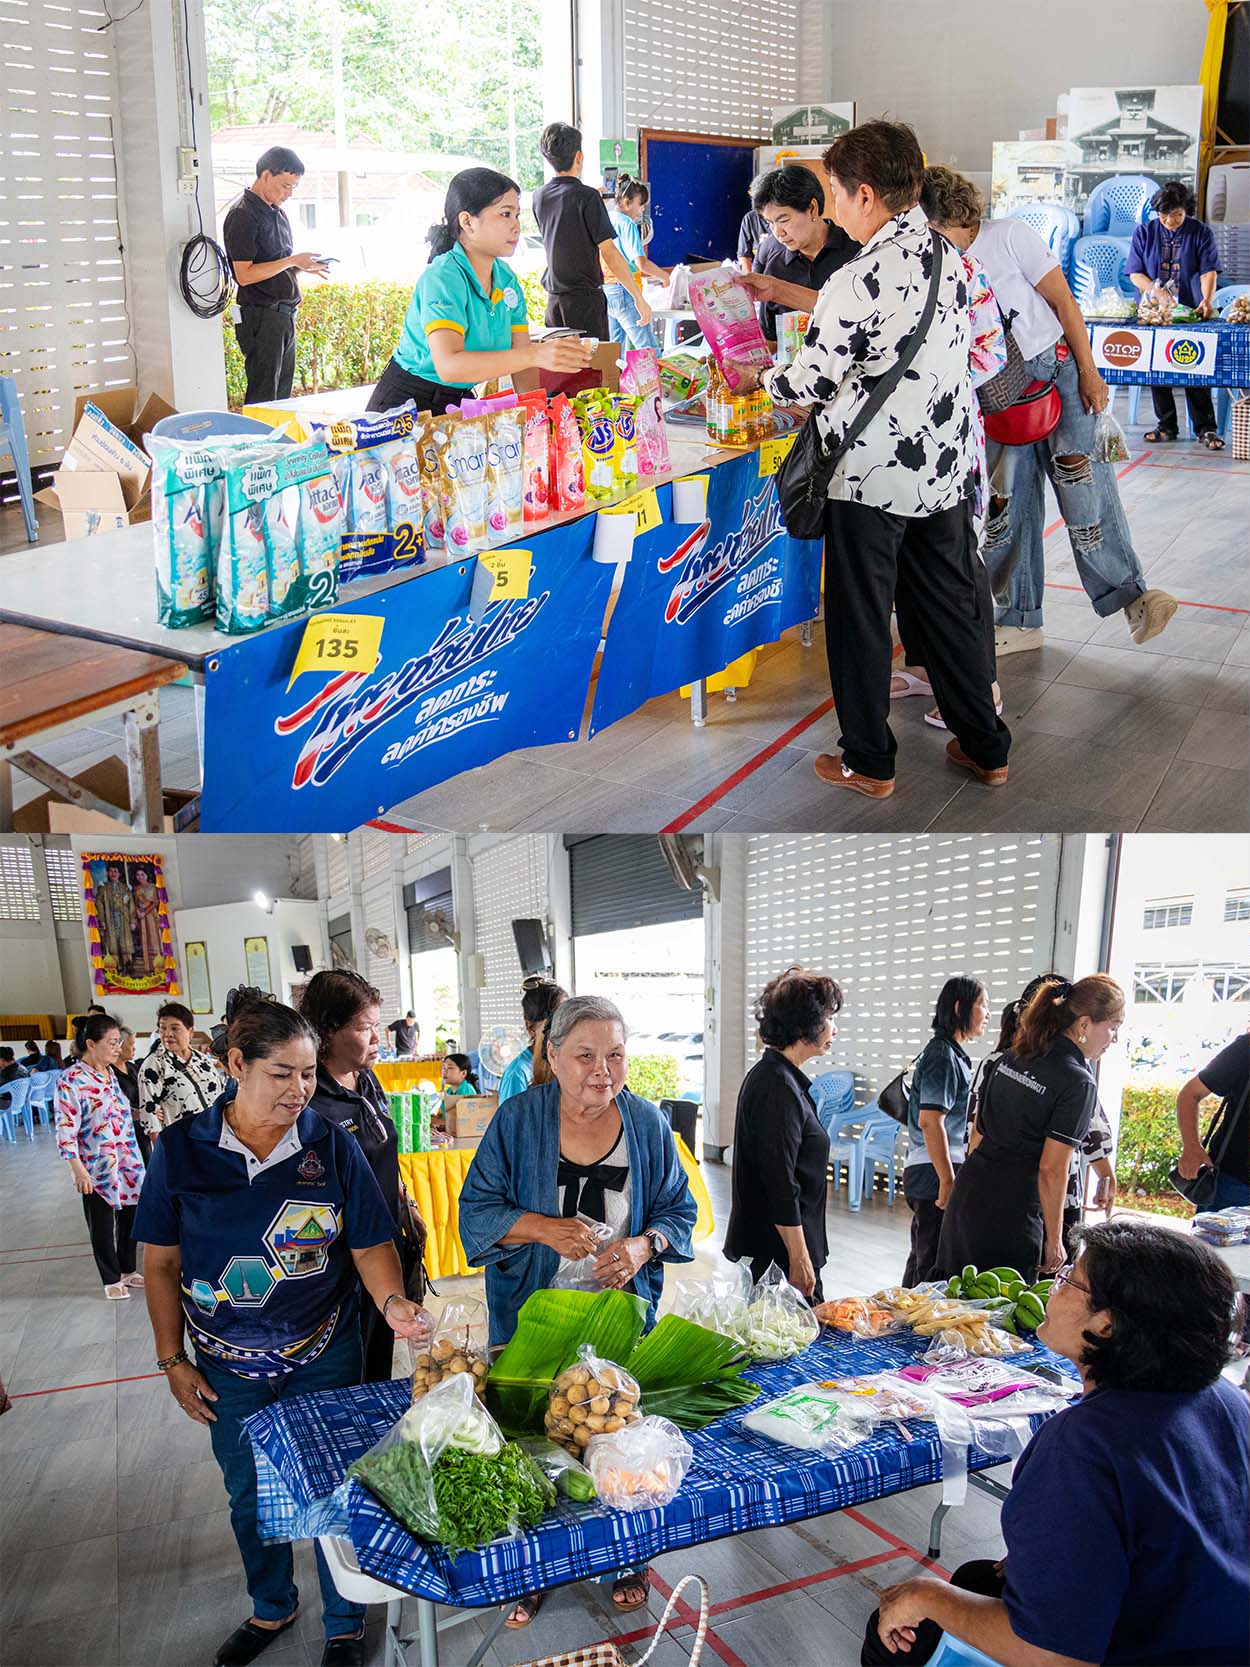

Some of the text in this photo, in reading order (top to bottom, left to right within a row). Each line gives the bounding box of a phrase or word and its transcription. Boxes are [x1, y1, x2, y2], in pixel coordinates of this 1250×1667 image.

[1104, 343, 1141, 355] OTOP
[392, 413, 414, 435] 45
[249, 465, 272, 481] แพ็ก
[249, 481, 273, 496] พิเศษ
[315, 638, 359, 658] 135
[415, 670, 498, 725] ลดภาระ
[380, 691, 510, 766] ลดค่าครองชีพ
